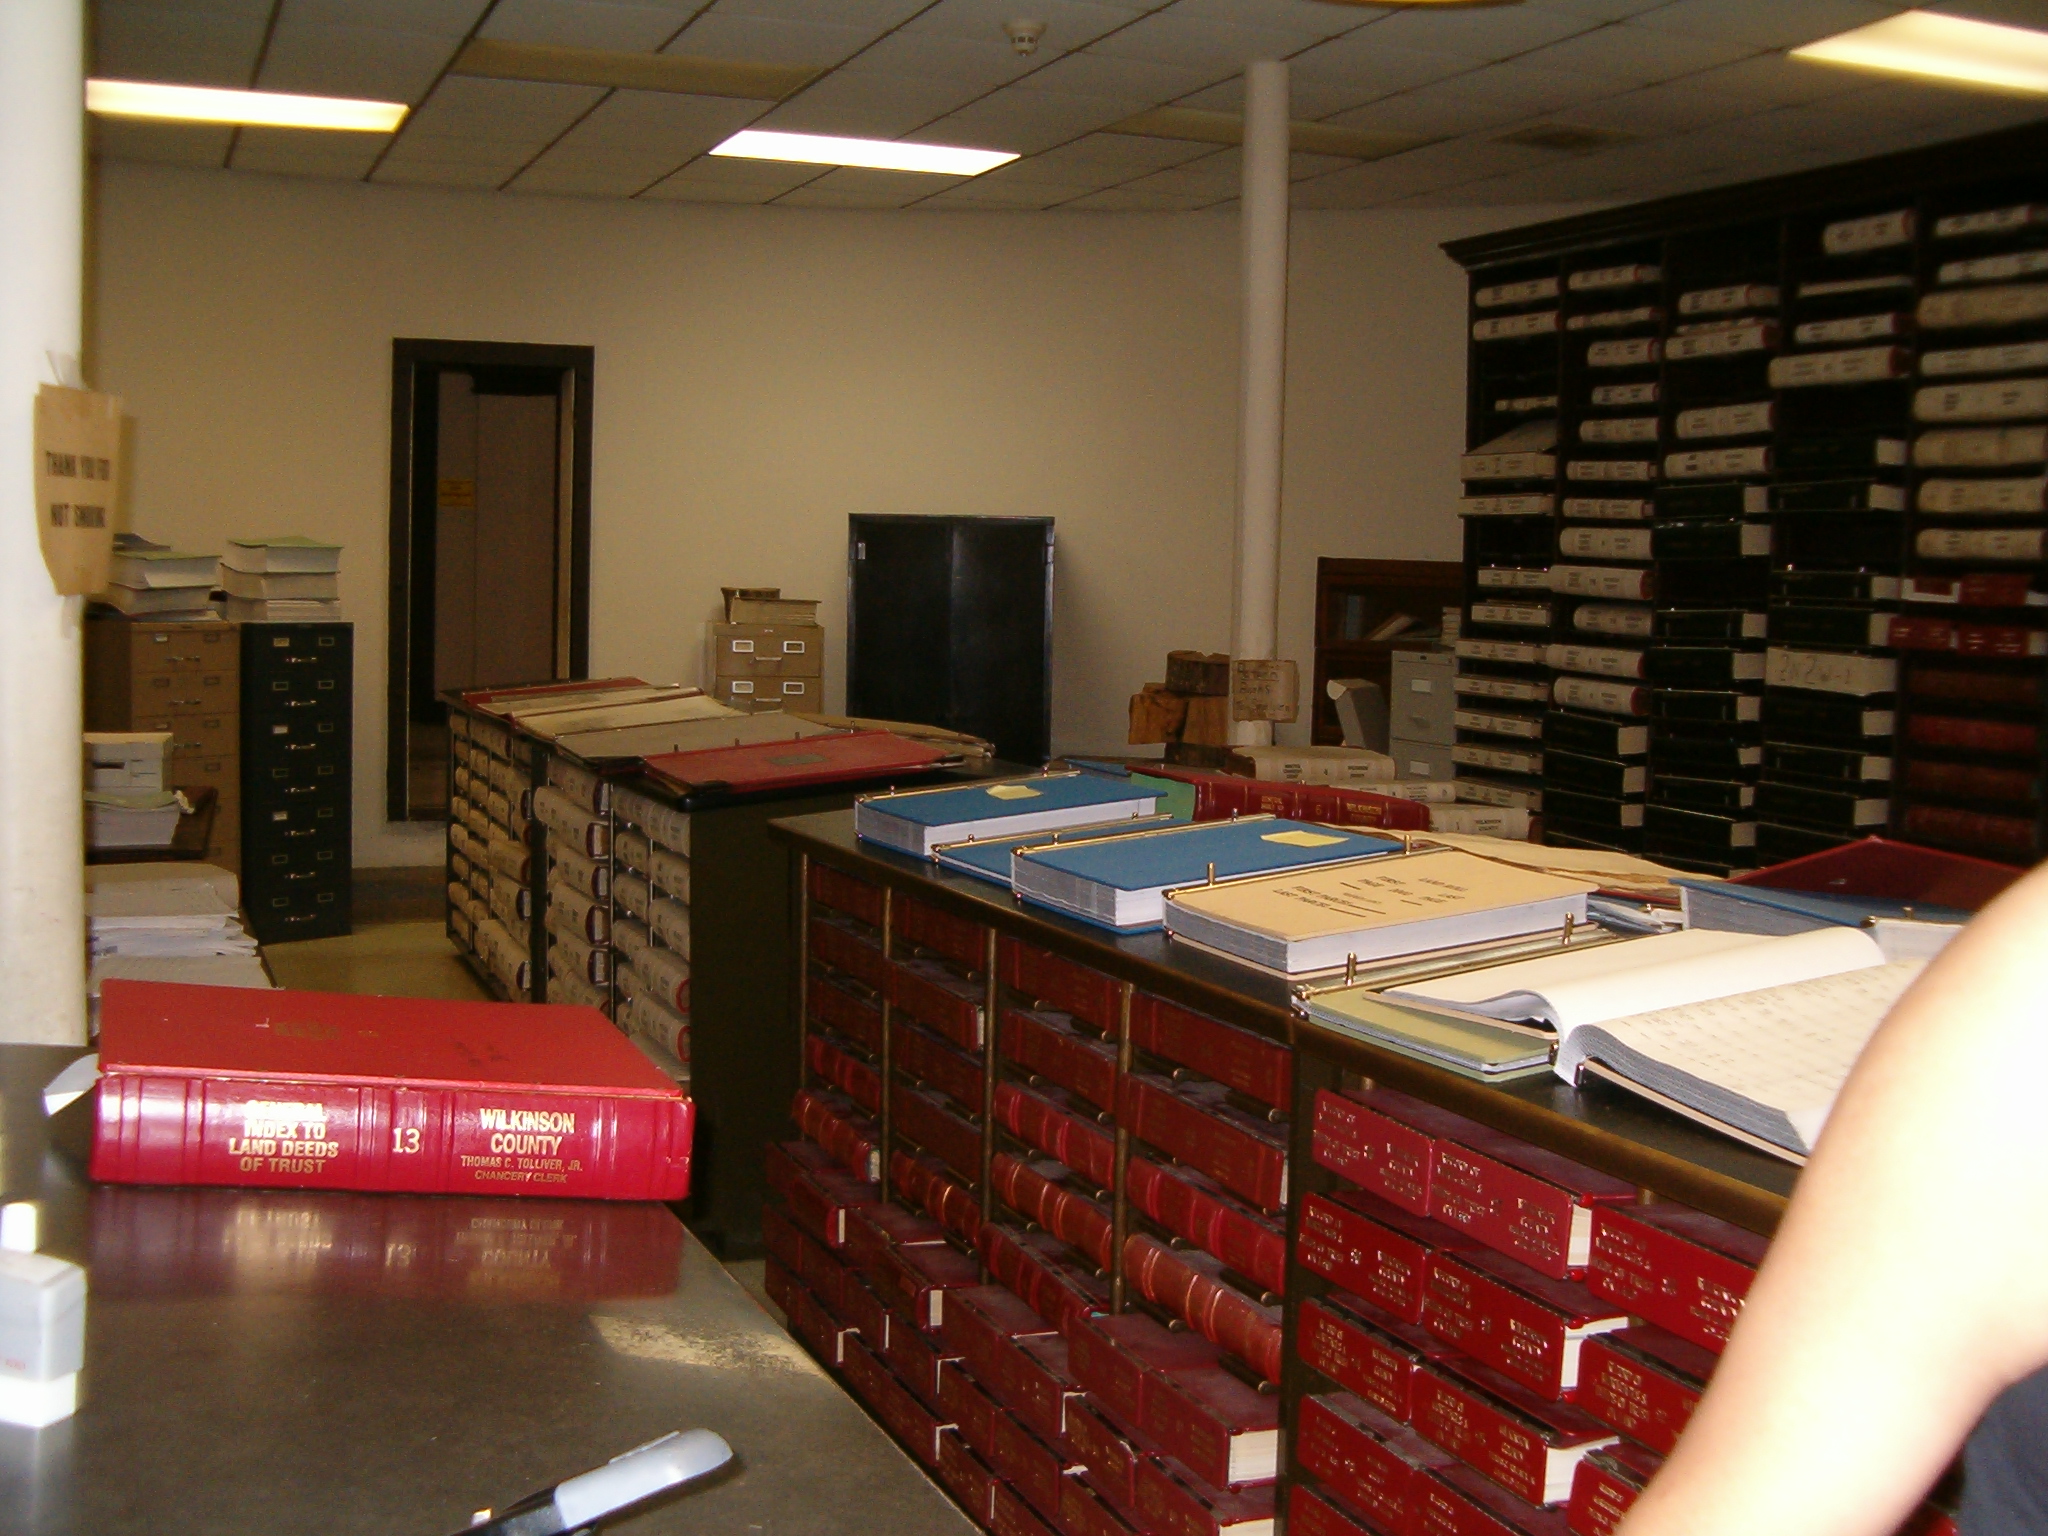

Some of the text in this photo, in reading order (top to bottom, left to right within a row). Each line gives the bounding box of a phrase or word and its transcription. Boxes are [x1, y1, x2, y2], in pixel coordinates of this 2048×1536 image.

[244, 1120, 326, 1139] INDEX TO
[480, 1108, 575, 1133] WILKINSON
[229, 1137, 339, 1158] LAND DEEDS
[393, 1127, 420, 1153] 13
[490, 1133, 562, 1155] COUNTY
[240, 1157, 326, 1174] OF TRUST
[461, 1155, 501, 1168] THOMAS
[533, 1172, 567, 1183] CLERK
